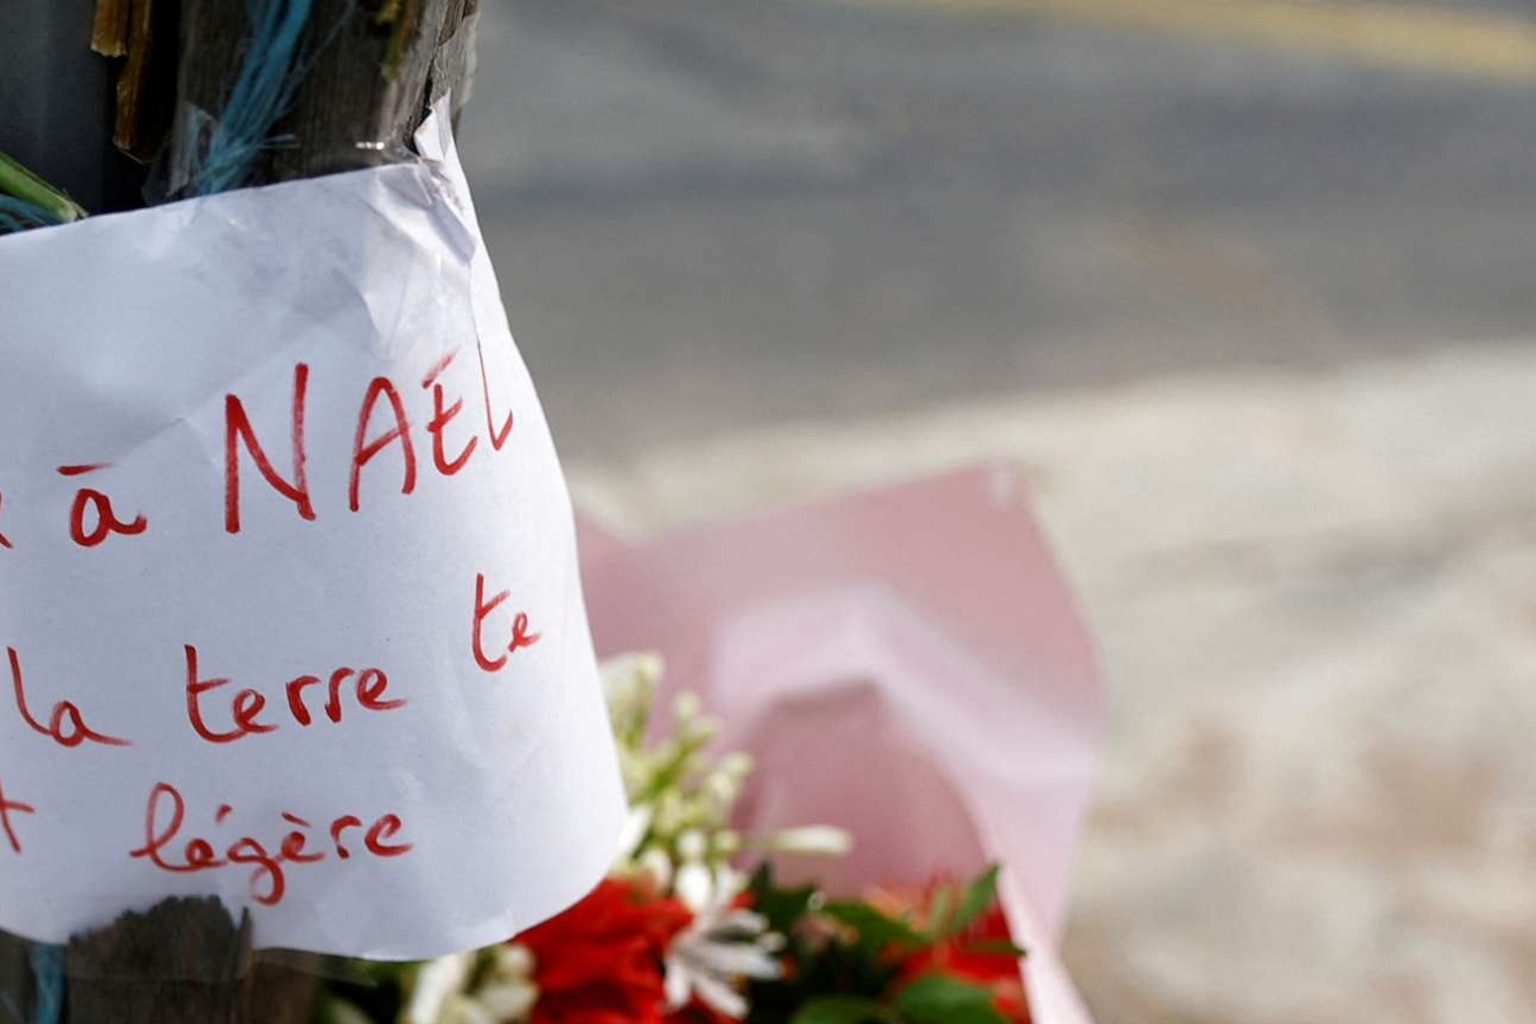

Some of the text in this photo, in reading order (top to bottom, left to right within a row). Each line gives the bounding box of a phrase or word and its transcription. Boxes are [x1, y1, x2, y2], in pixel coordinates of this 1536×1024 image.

[6, 646, 134, 747] la
[184, 644, 406, 744] terre
[472, 572, 541, 673] te
[129, 782, 415, 905] légère
